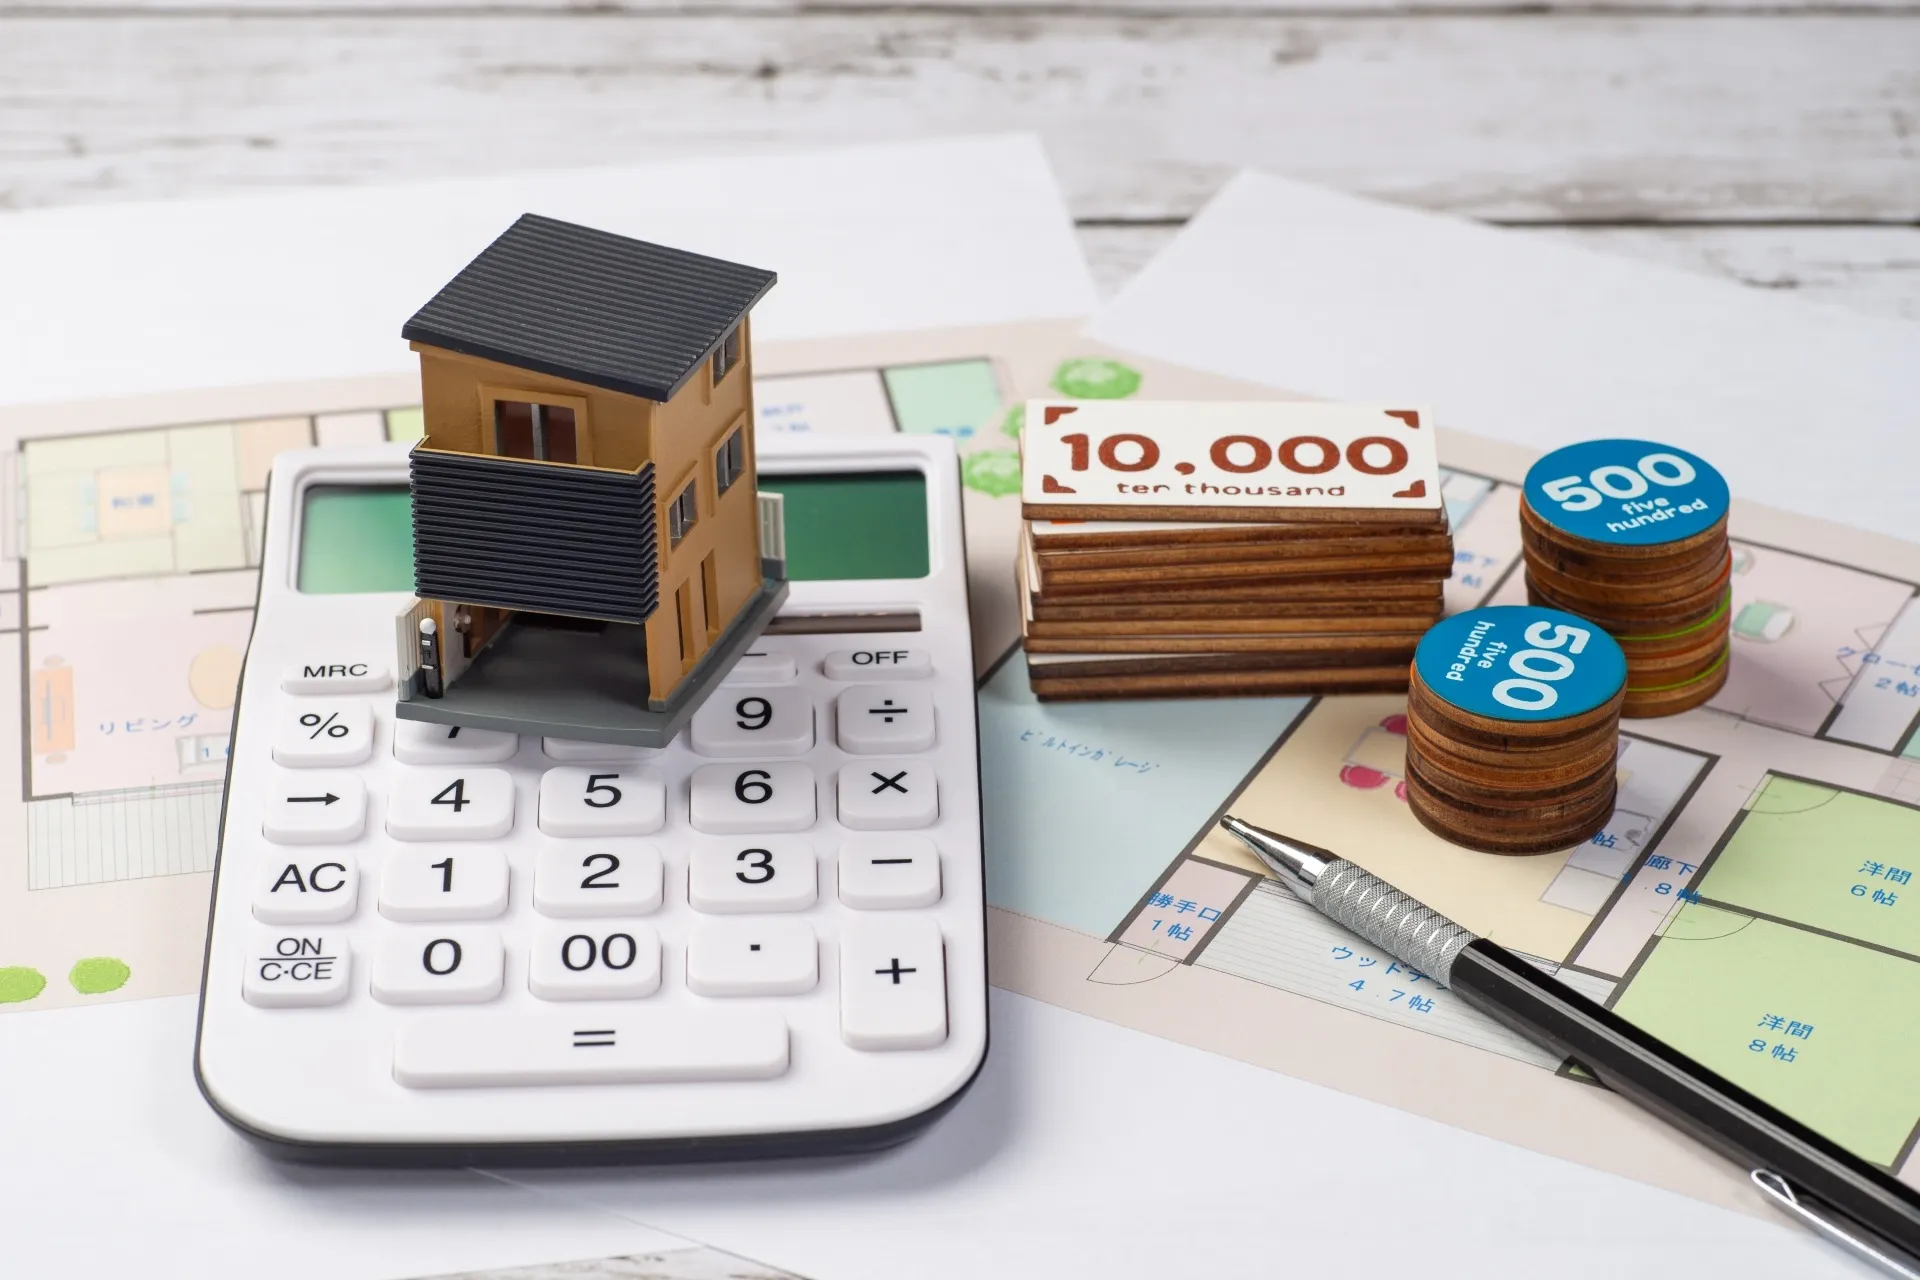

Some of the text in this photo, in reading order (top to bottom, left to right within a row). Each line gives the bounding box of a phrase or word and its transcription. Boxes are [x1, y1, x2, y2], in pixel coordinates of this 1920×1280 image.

[1184, 483, 1345, 498] thousand
[1542, 453, 1696, 511] 500
[1606, 498, 1708, 532] hundred
[1622, 497, 1670, 515] five
[852, 650, 909, 664] OFF
[1446, 621, 1495, 681] hundred
[1477, 641, 1507, 668] five
[1492, 621, 1590, 710] 500
[304, 664, 368, 678] MRC
[99, 713, 199, 734] リビング
[736, 697, 773, 730] 9
[431, 778, 470, 812] 4
[583, 774, 622, 807] 5
[734, 770, 773, 803] 6
[270, 863, 346, 894] AC
[430, 857, 455, 892] 1
[580, 854, 620, 889] 2
[735, 848, 775, 883] 3
[1644, 855, 1698, 875] 廊下
[1858, 860, 1912, 885] 洋間
[1147, 891, 1222, 922] 勝手口
[276, 938, 322, 956] ON
[422, 939, 462, 975] 0
[561, 934, 637, 971] 00
[1757, 1013, 1814, 1040] 洋間
[1749, 1039, 1799, 1063] 8帖
